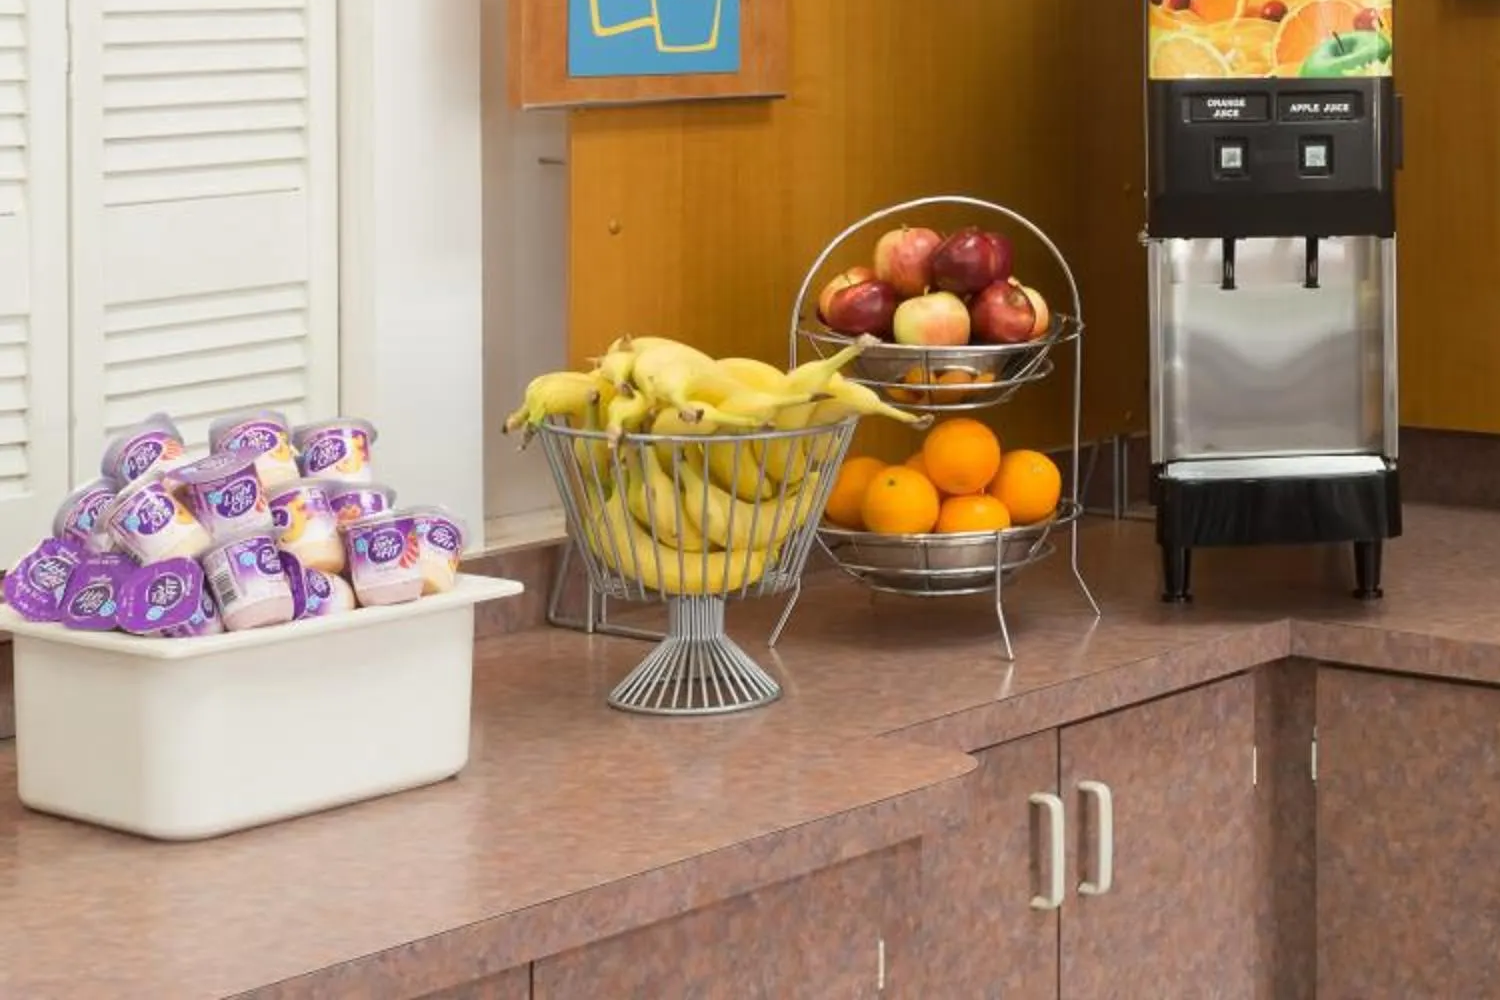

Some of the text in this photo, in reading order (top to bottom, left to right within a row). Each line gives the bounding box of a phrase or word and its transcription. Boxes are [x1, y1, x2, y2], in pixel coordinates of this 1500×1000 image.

[1207, 98, 1246, 107] ORANGE
[1212, 108, 1239, 118] JUICE
[1290, 103, 1350, 113] APPLE JUICE
